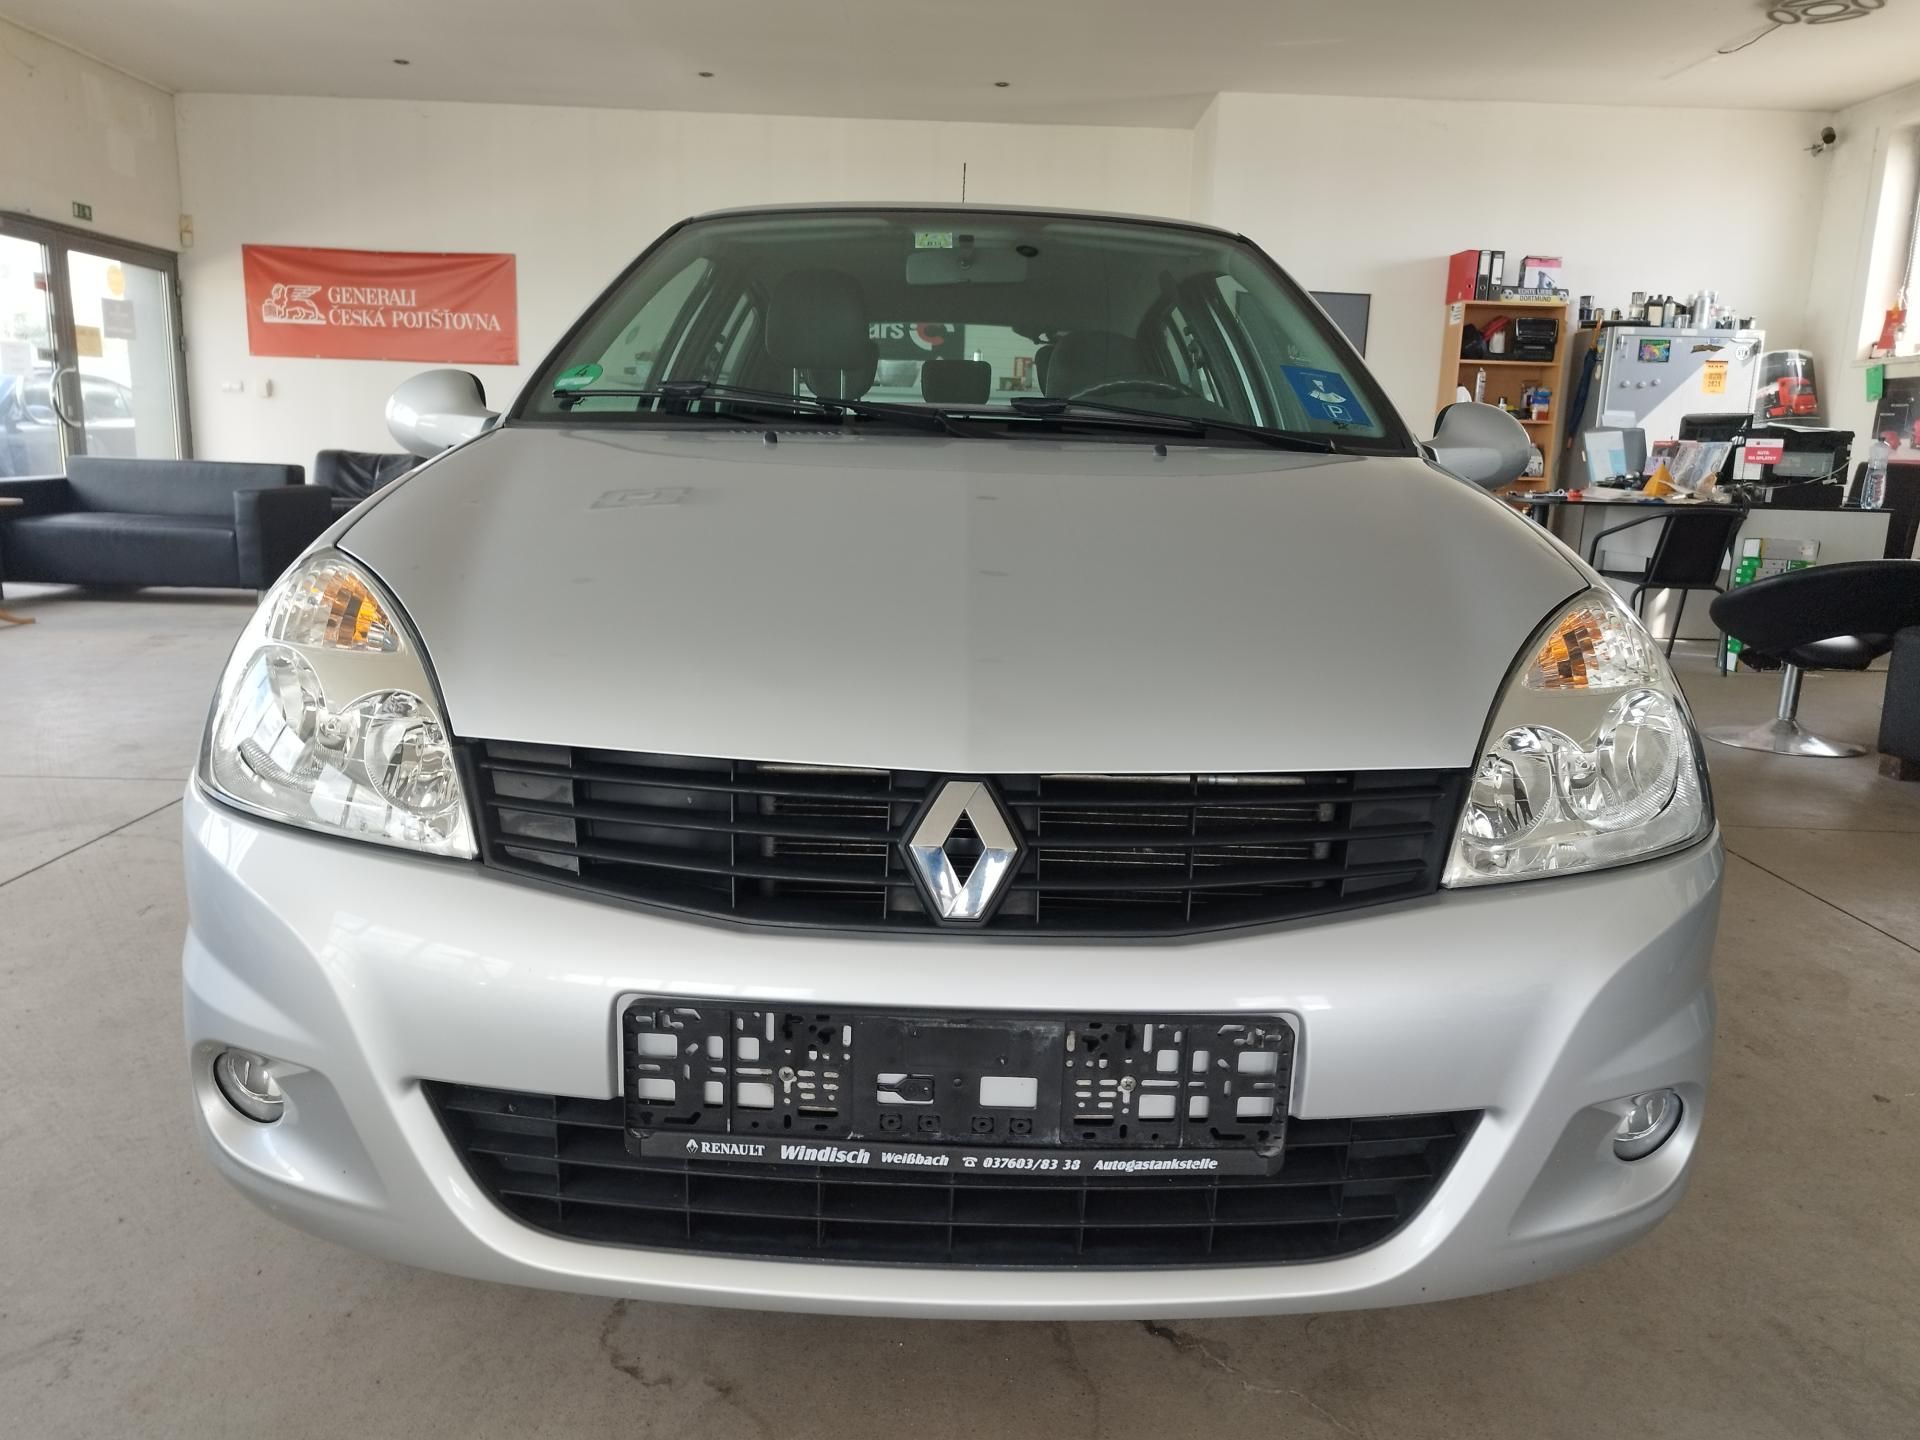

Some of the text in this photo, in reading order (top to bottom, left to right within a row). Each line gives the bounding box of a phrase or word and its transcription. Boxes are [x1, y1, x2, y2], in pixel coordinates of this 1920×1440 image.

[328, 286, 417, 307] GENERALI
[328, 305, 501, 332] ČESKÁ POJIŠŤOVNA
[701, 1141, 1219, 1173] RENAULT Windisch Weißbach 037603/83 38 Autogastankstelle
